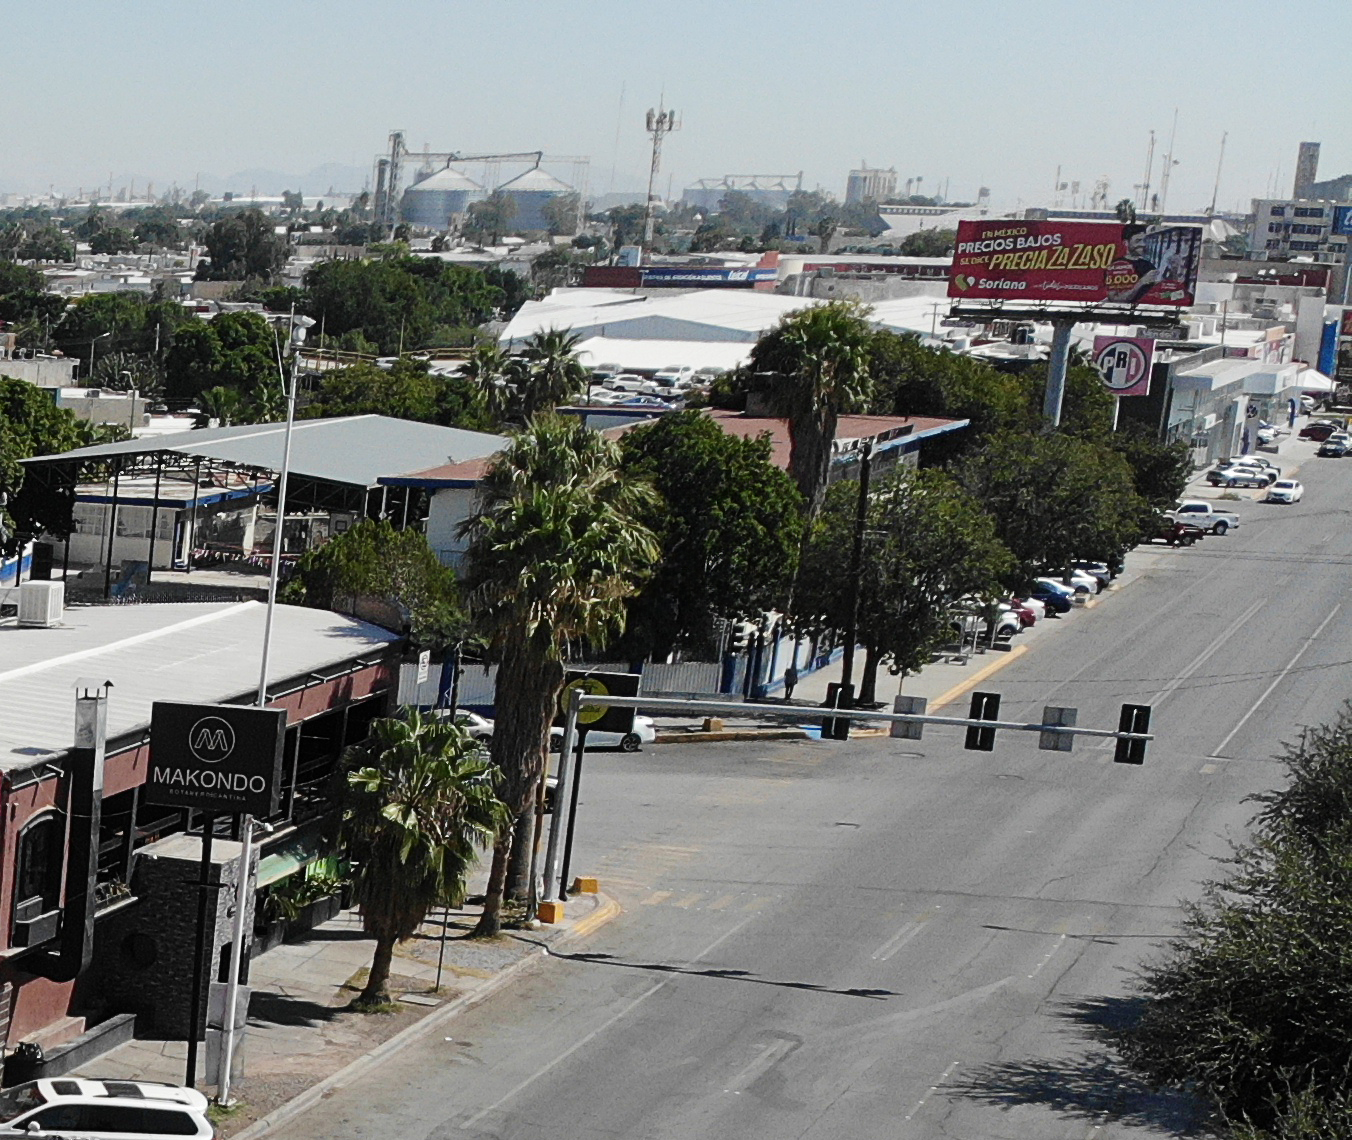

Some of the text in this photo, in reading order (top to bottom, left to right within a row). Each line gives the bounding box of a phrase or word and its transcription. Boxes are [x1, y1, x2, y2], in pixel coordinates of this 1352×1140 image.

[958, 233, 1061, 254] PRECIOS BAJOS
[978, 278, 1027, 290] Soriana
[1100, 350, 1137, 374] PRI
[153, 766, 266, 793] MAKONDO
